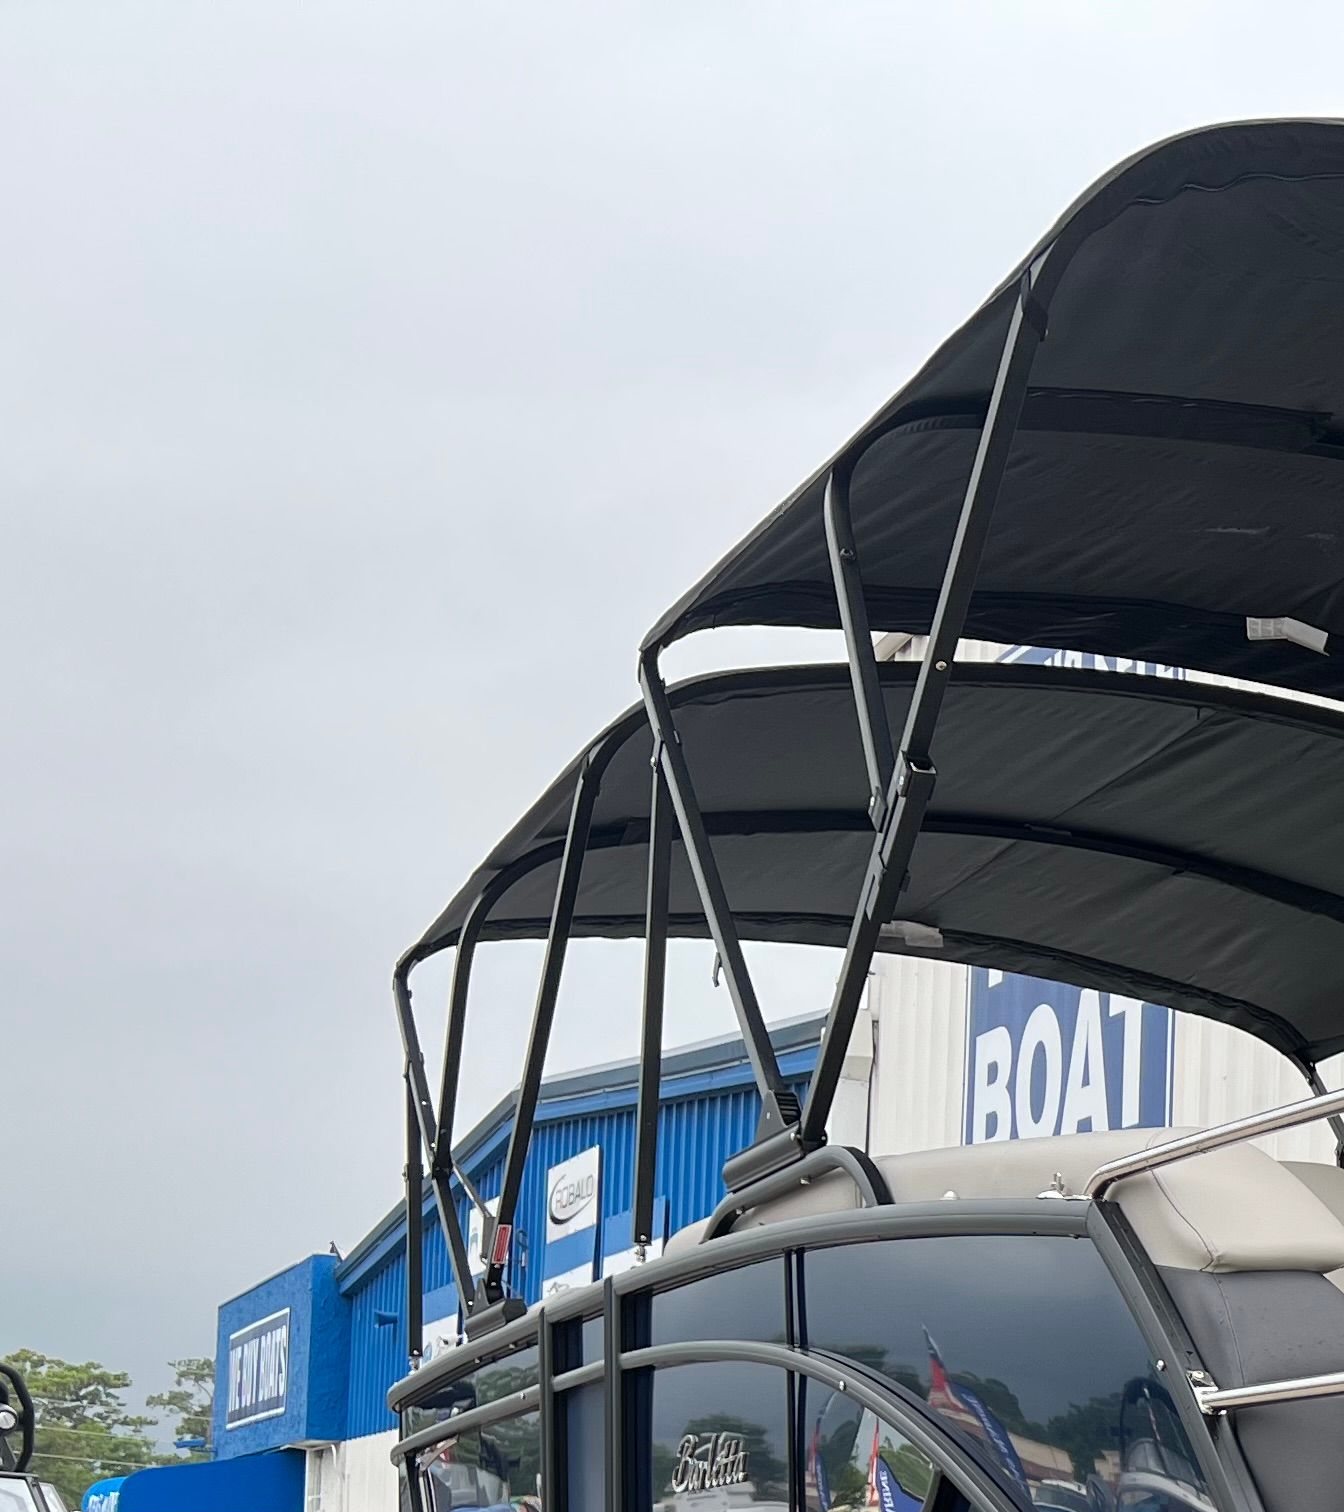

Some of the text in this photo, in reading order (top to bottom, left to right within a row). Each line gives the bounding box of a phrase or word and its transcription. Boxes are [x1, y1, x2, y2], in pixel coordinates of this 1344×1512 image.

[972, 988, 1146, 1145] BOAT
[555, 1173, 595, 1211] ROBALO
[671, 1432, 749, 1493] Barletta
